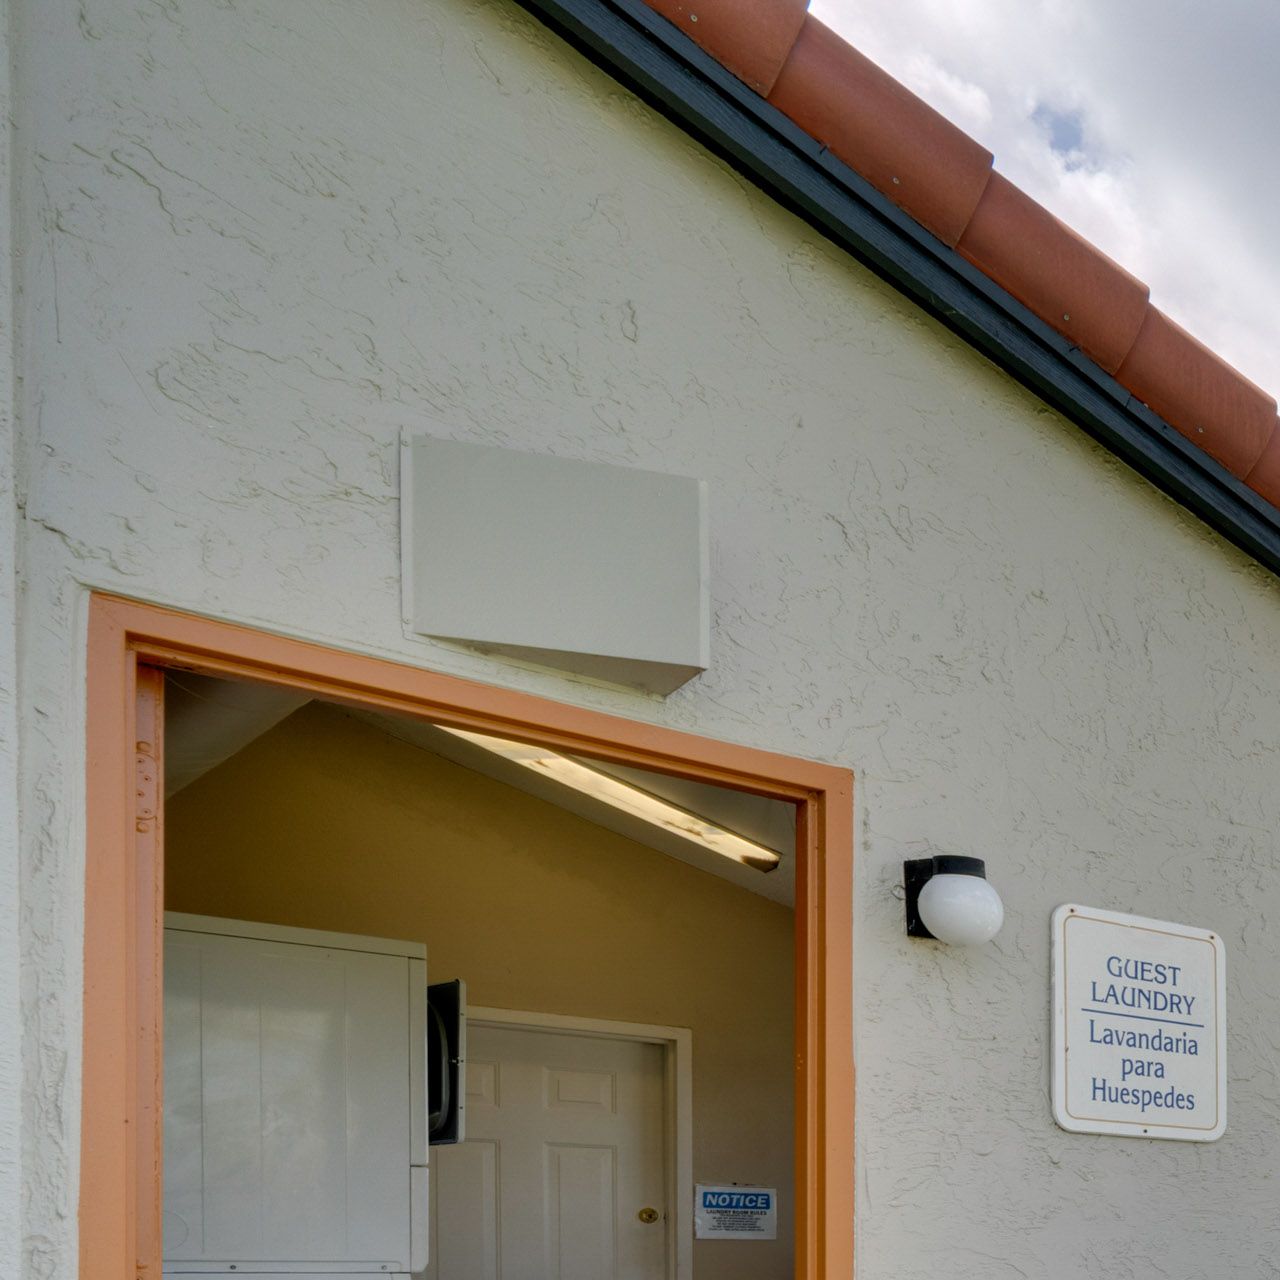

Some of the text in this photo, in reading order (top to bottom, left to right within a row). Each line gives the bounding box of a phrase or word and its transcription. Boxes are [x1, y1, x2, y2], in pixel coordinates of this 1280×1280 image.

[1106, 956, 1181, 986] GUEST
[1091, 981, 1195, 1015] LAUNDRY
[1089, 1019, 1198, 1056] Lavandaria
[1121, 1058, 1165, 1081] para
[1092, 1078, 1195, 1112] Huespedes
[706, 1194, 768, 1207] NOTICE
